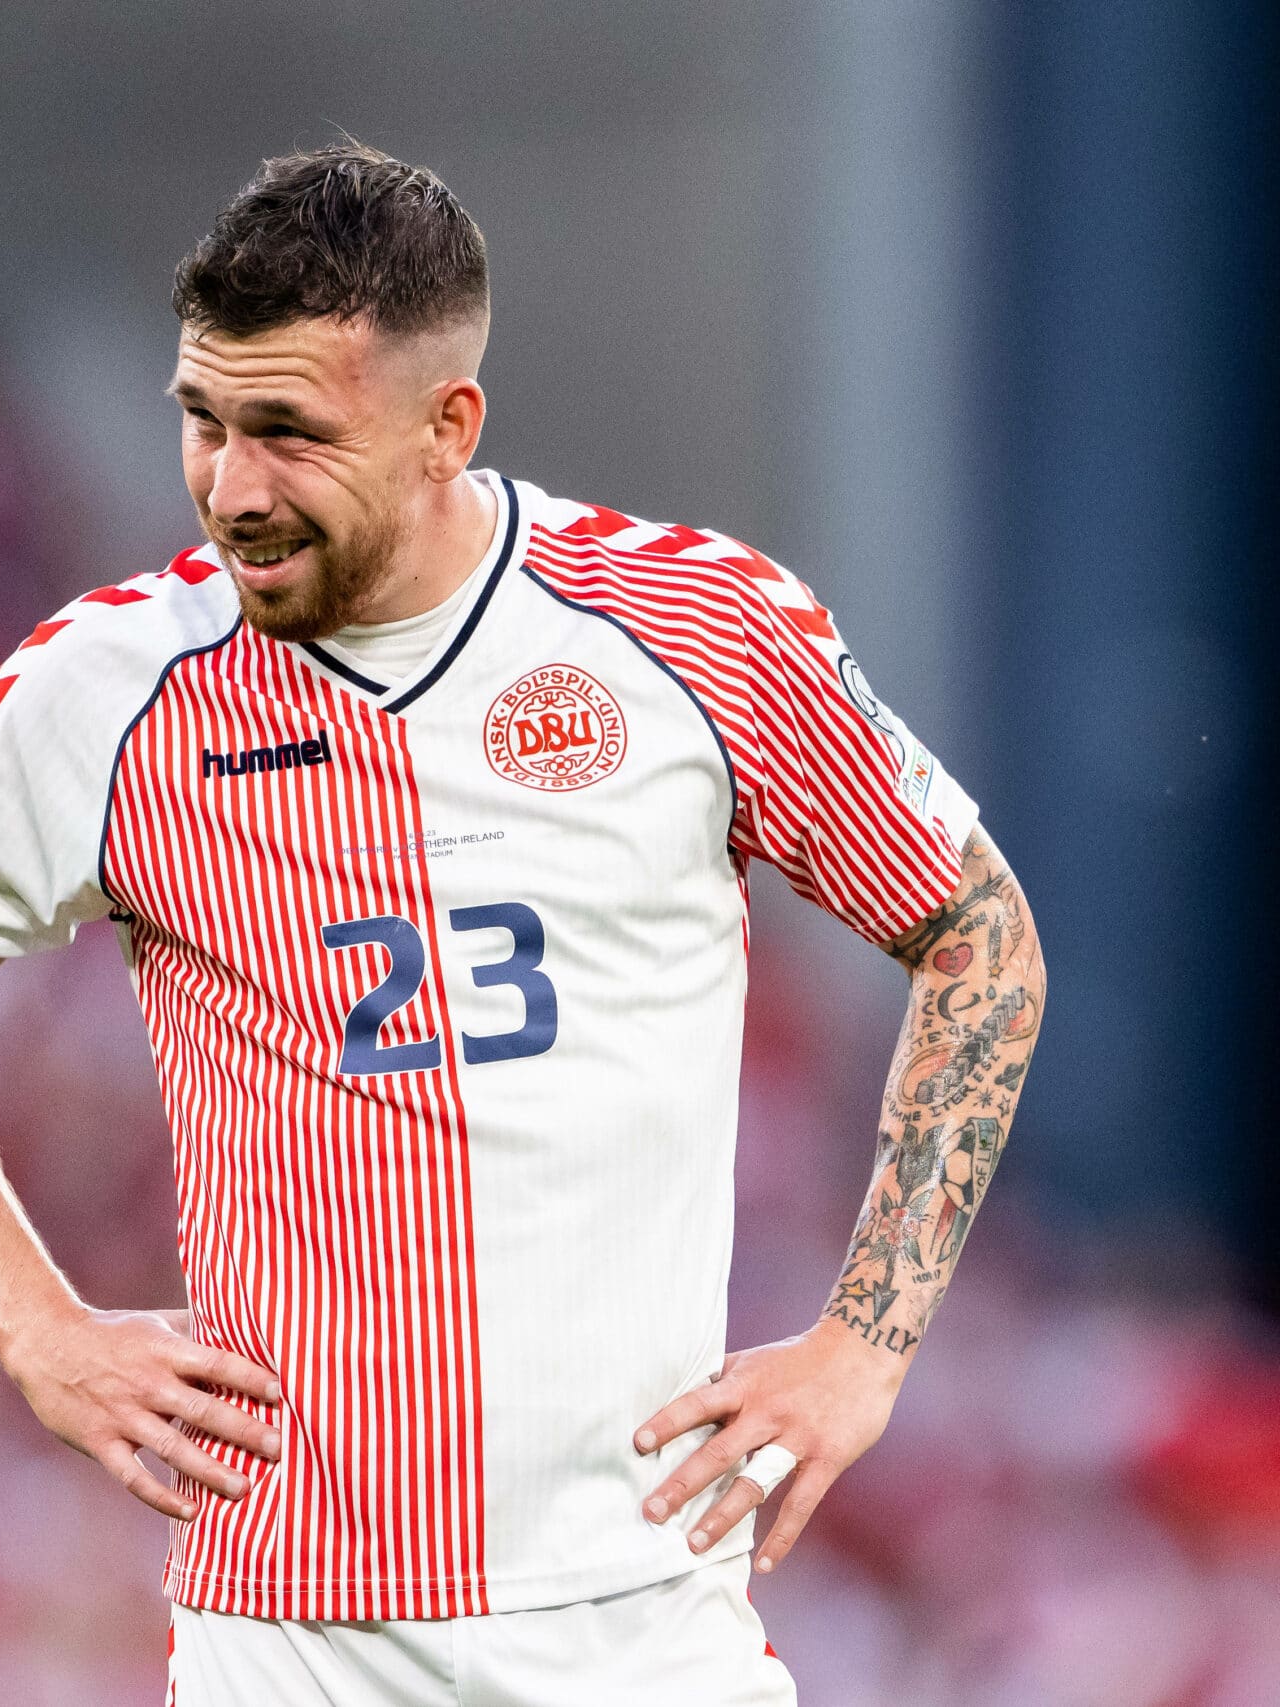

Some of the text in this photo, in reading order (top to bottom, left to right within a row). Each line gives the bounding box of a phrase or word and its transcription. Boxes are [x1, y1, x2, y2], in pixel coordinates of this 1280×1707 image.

[202, 729, 332, 779] hummel
[490, 713, 530, 783] DANSK
[538, 773, 593, 788] 1889
[513, 710, 598, 757] DBU
[339, 845, 388, 855] DEMR
[400, 837, 458, 852] OTHERN
[460, 831, 505, 845] IRELAND
[422, 849, 453, 859] TADIUM
[319, 901, 559, 1076] 23
